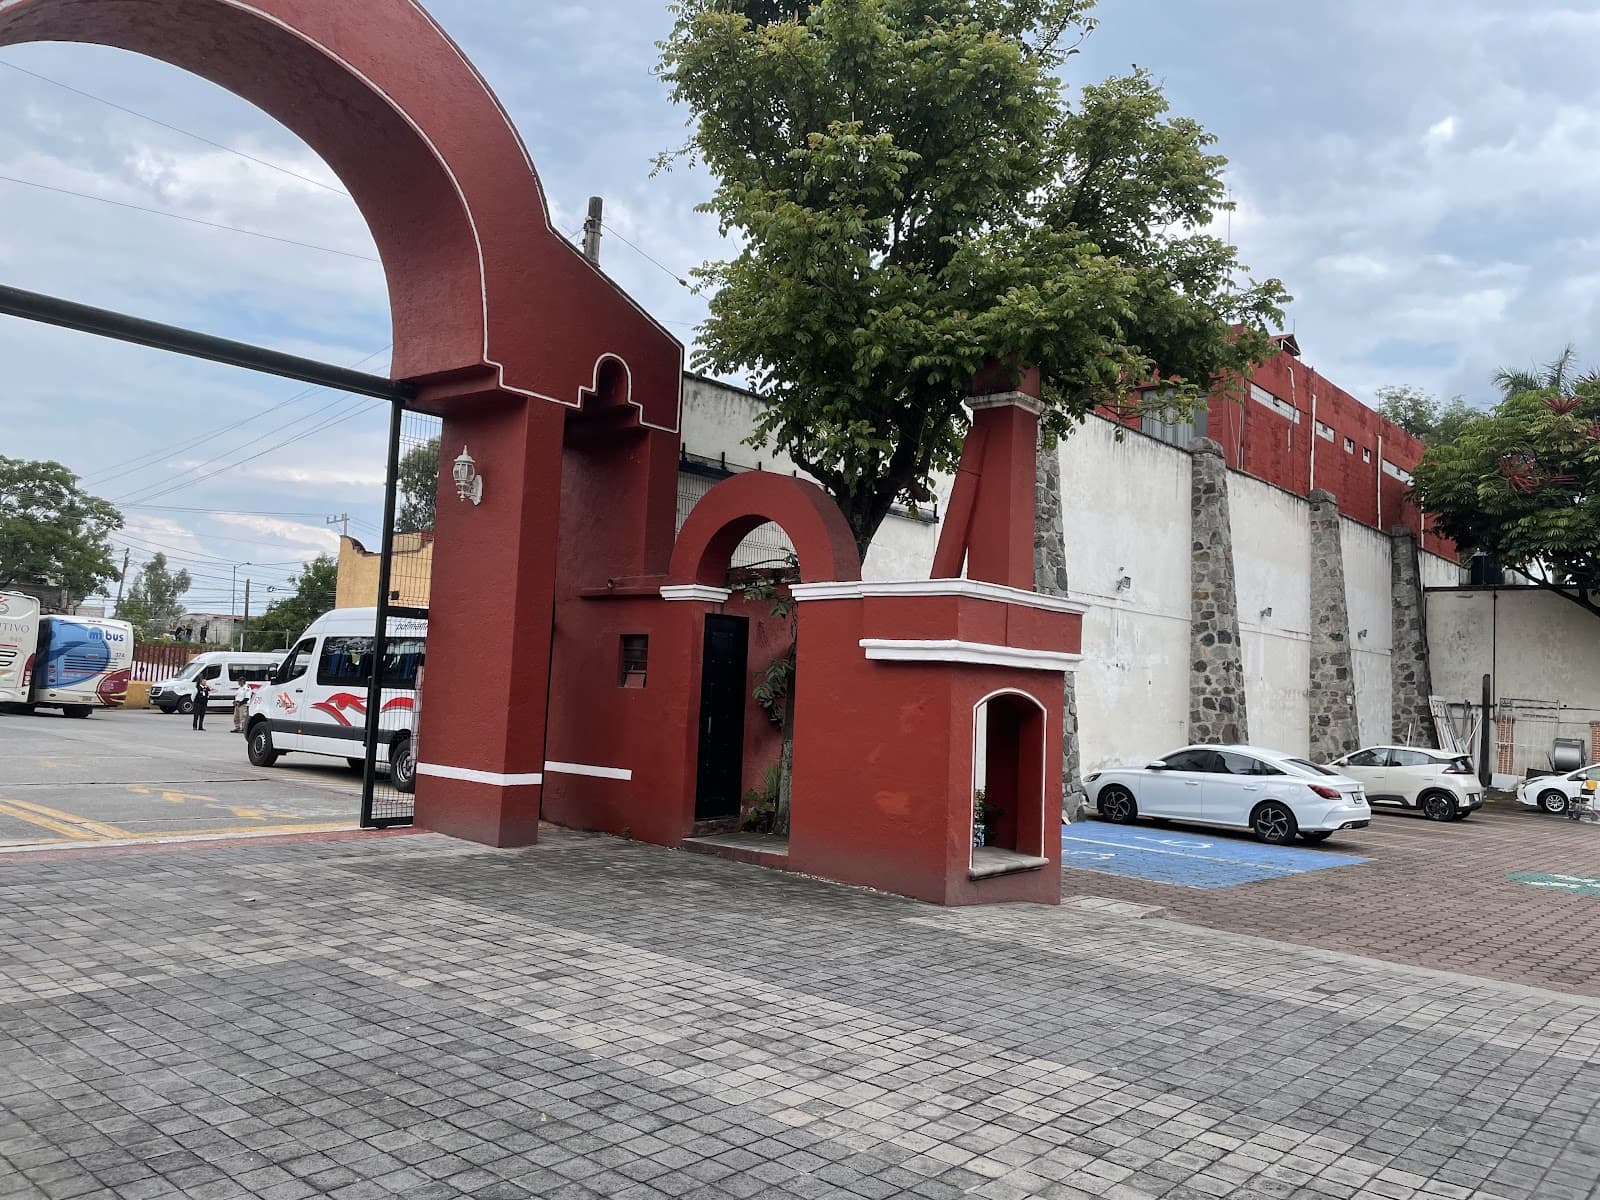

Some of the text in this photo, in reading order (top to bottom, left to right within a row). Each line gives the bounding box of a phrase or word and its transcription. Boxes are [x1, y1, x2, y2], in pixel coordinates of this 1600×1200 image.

[0, 622, 30, 633] TIVO
[89, 630, 124, 642] mi bus
